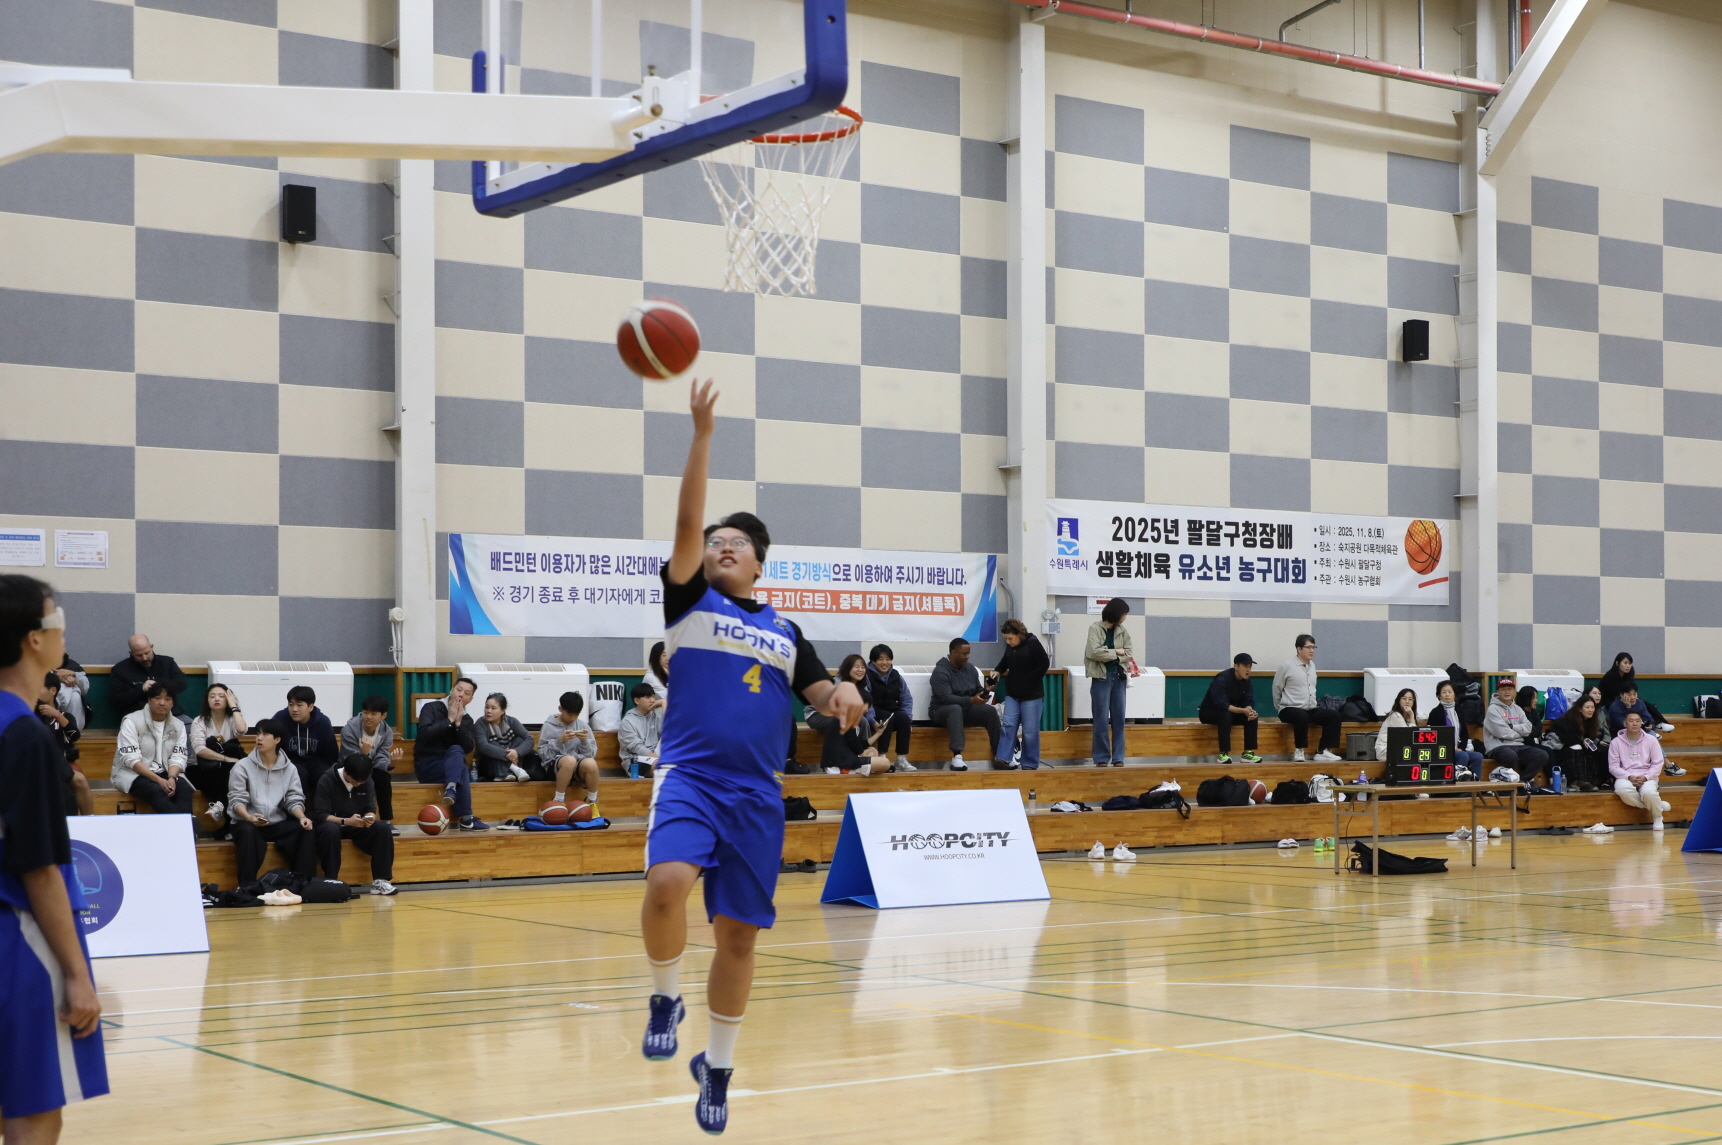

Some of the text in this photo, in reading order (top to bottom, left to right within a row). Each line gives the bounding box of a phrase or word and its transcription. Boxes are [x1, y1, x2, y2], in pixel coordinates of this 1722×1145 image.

[1112, 516, 1293, 550] 2025년 팔달구청장배
[1319, 525, 1331, 536] 일시
[1319, 541, 1331, 552] 장소
[1338, 542, 1362, 554] 숙지공원
[1364, 543, 1398, 555] 다목적체육관
[490, 551, 537, 573] 배드민턴
[541, 553, 587, 575] 이용자가
[589, 554, 611, 576] 많은
[791, 562, 852, 583] 경기방식으로
[855, 564, 893, 584] 이용하여
[896, 565, 924, 586] 주시기
[927, 567, 967, 586] 바랍니다.
[1049, 557, 1089, 571] 수원특례시
[1096, 550, 1307, 584] 생활체육 유소년 농구대회
[1319, 557, 1331, 568] 주최
[1338, 558, 1356, 569] 수원시
[1358, 560, 1382, 571] 팔달구청
[1319, 574, 1331, 585] 주관
[1338, 575, 1356, 586] 수원시
[1358, 576, 1381, 587] 농구협회
[509, 585, 535, 604] 경기
[538, 586, 564, 604] 종료
[567, 586, 580, 604] 후
[584, 587, 646, 606] 대기자에게
[649, 588, 665, 605] 코
[771, 590, 837, 612] 금지(코트),
[839, 592, 863, 611] 중복
[866, 593, 888, 612] 대기
[892, 594, 961, 613] 금지(셔틀콕)
[743, 664, 762, 693] 4
[1404, 747, 1445, 760] 0 24 0
[1412, 766, 1453, 780] 0 0 0
[890, 832, 1010, 850] HOOPCITY
[924, 853, 985, 861] WWW.HOOPCITY.CO.KR
